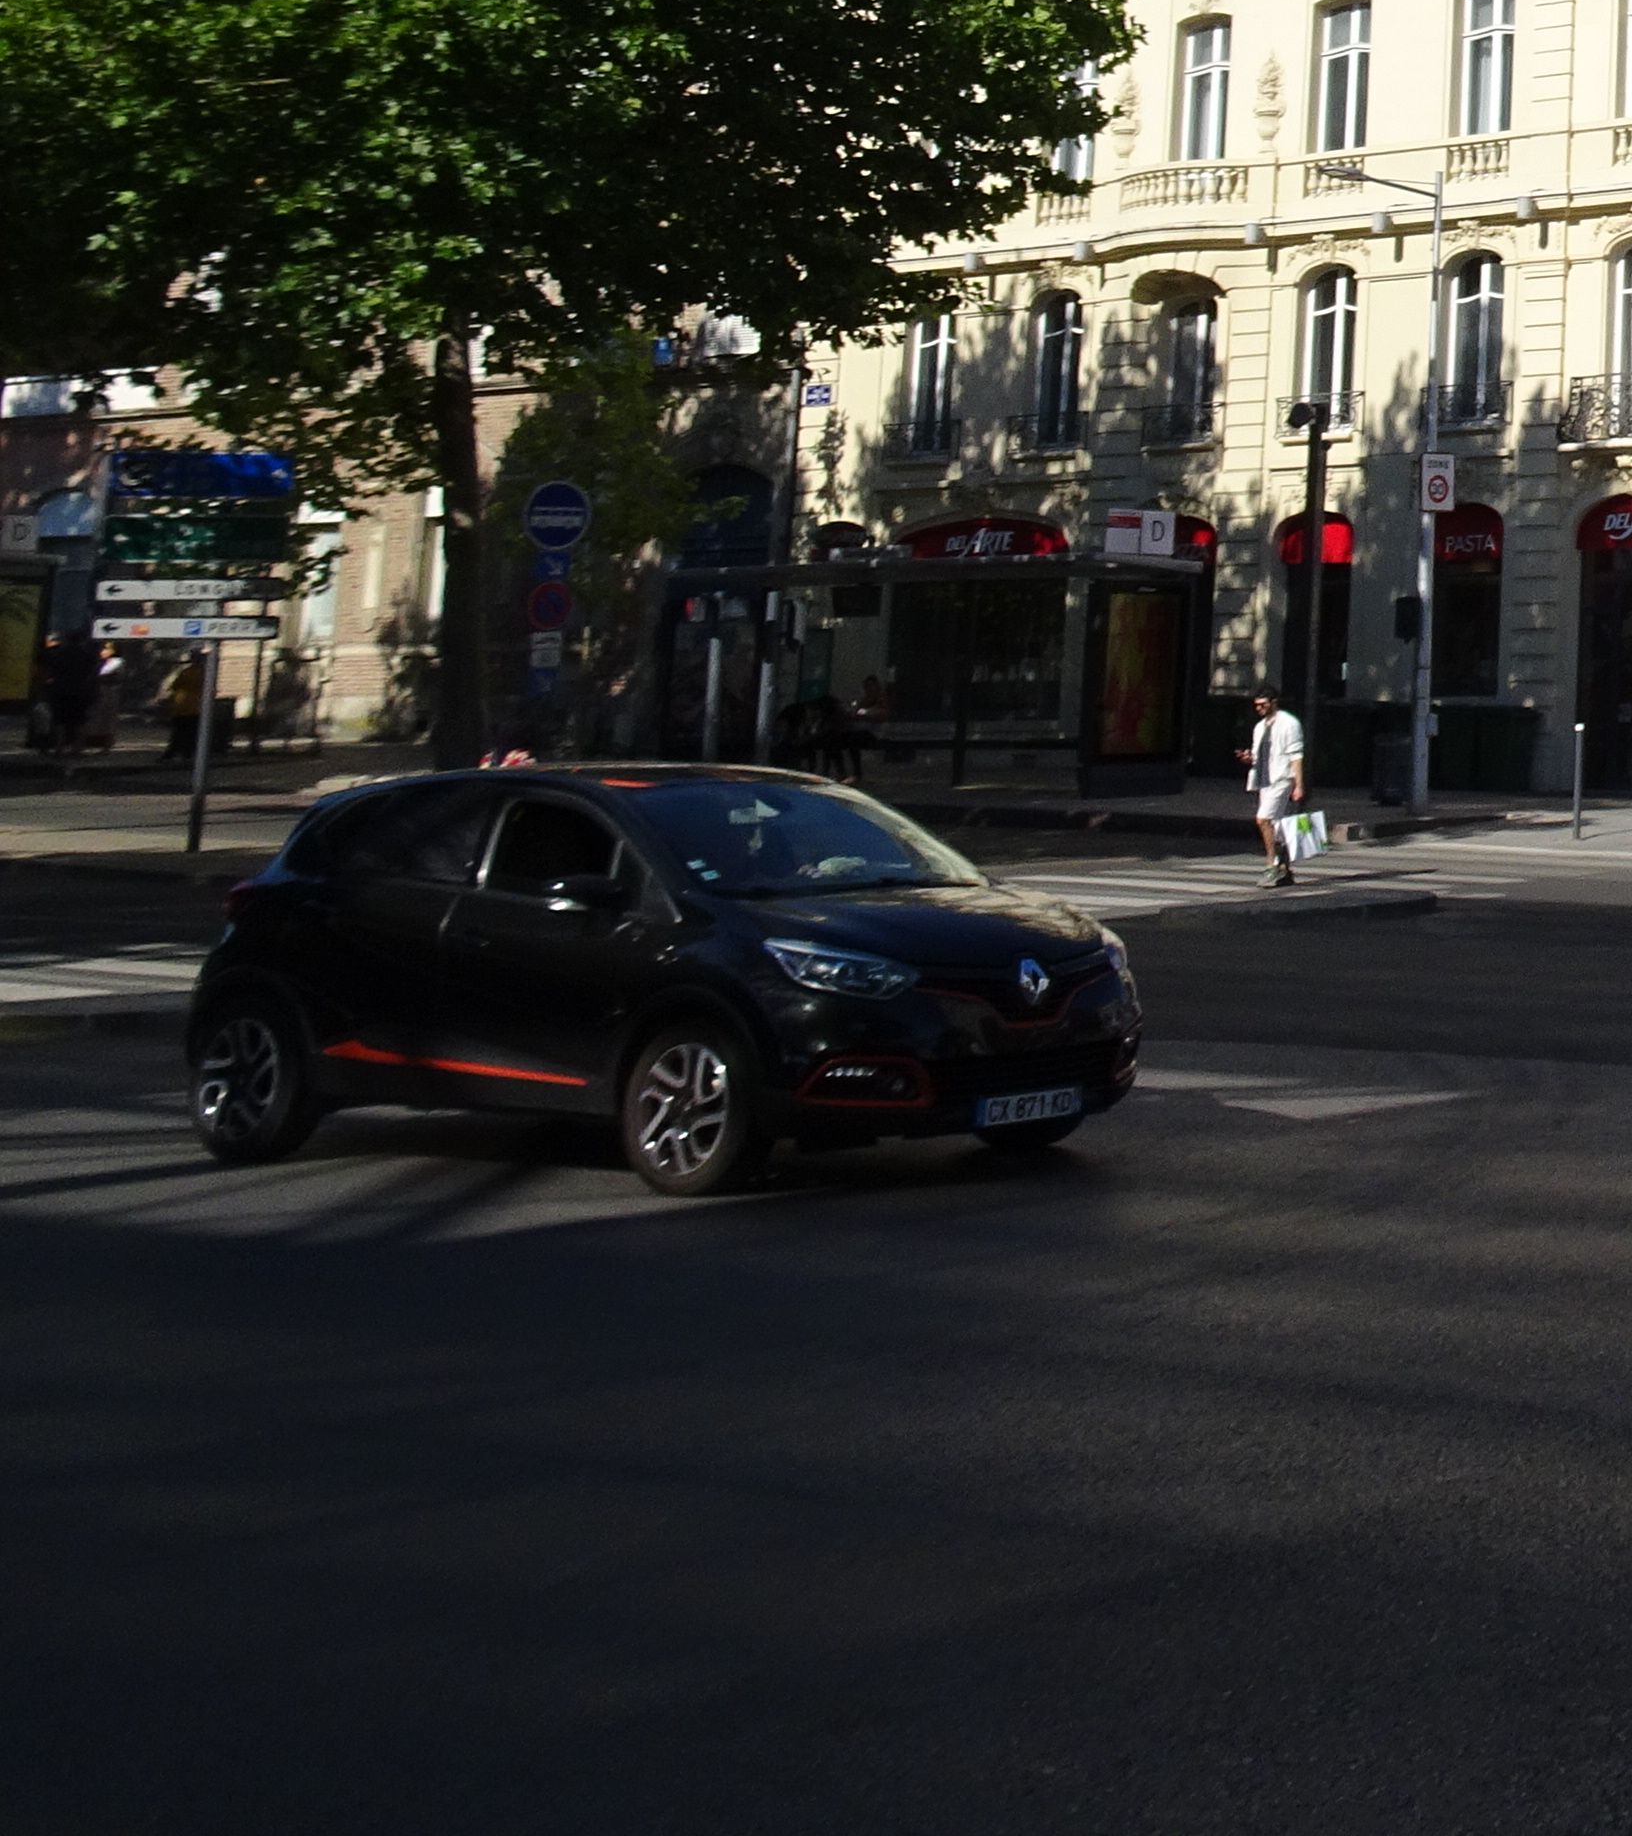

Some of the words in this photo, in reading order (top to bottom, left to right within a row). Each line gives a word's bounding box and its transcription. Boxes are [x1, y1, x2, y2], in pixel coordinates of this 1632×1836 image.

[1152, 521, 1165, 542] D
[1603, 513, 1632, 531] DEL
[955, 527, 1015, 556] ARTE
[1445, 534, 1496, 553] PASTA
